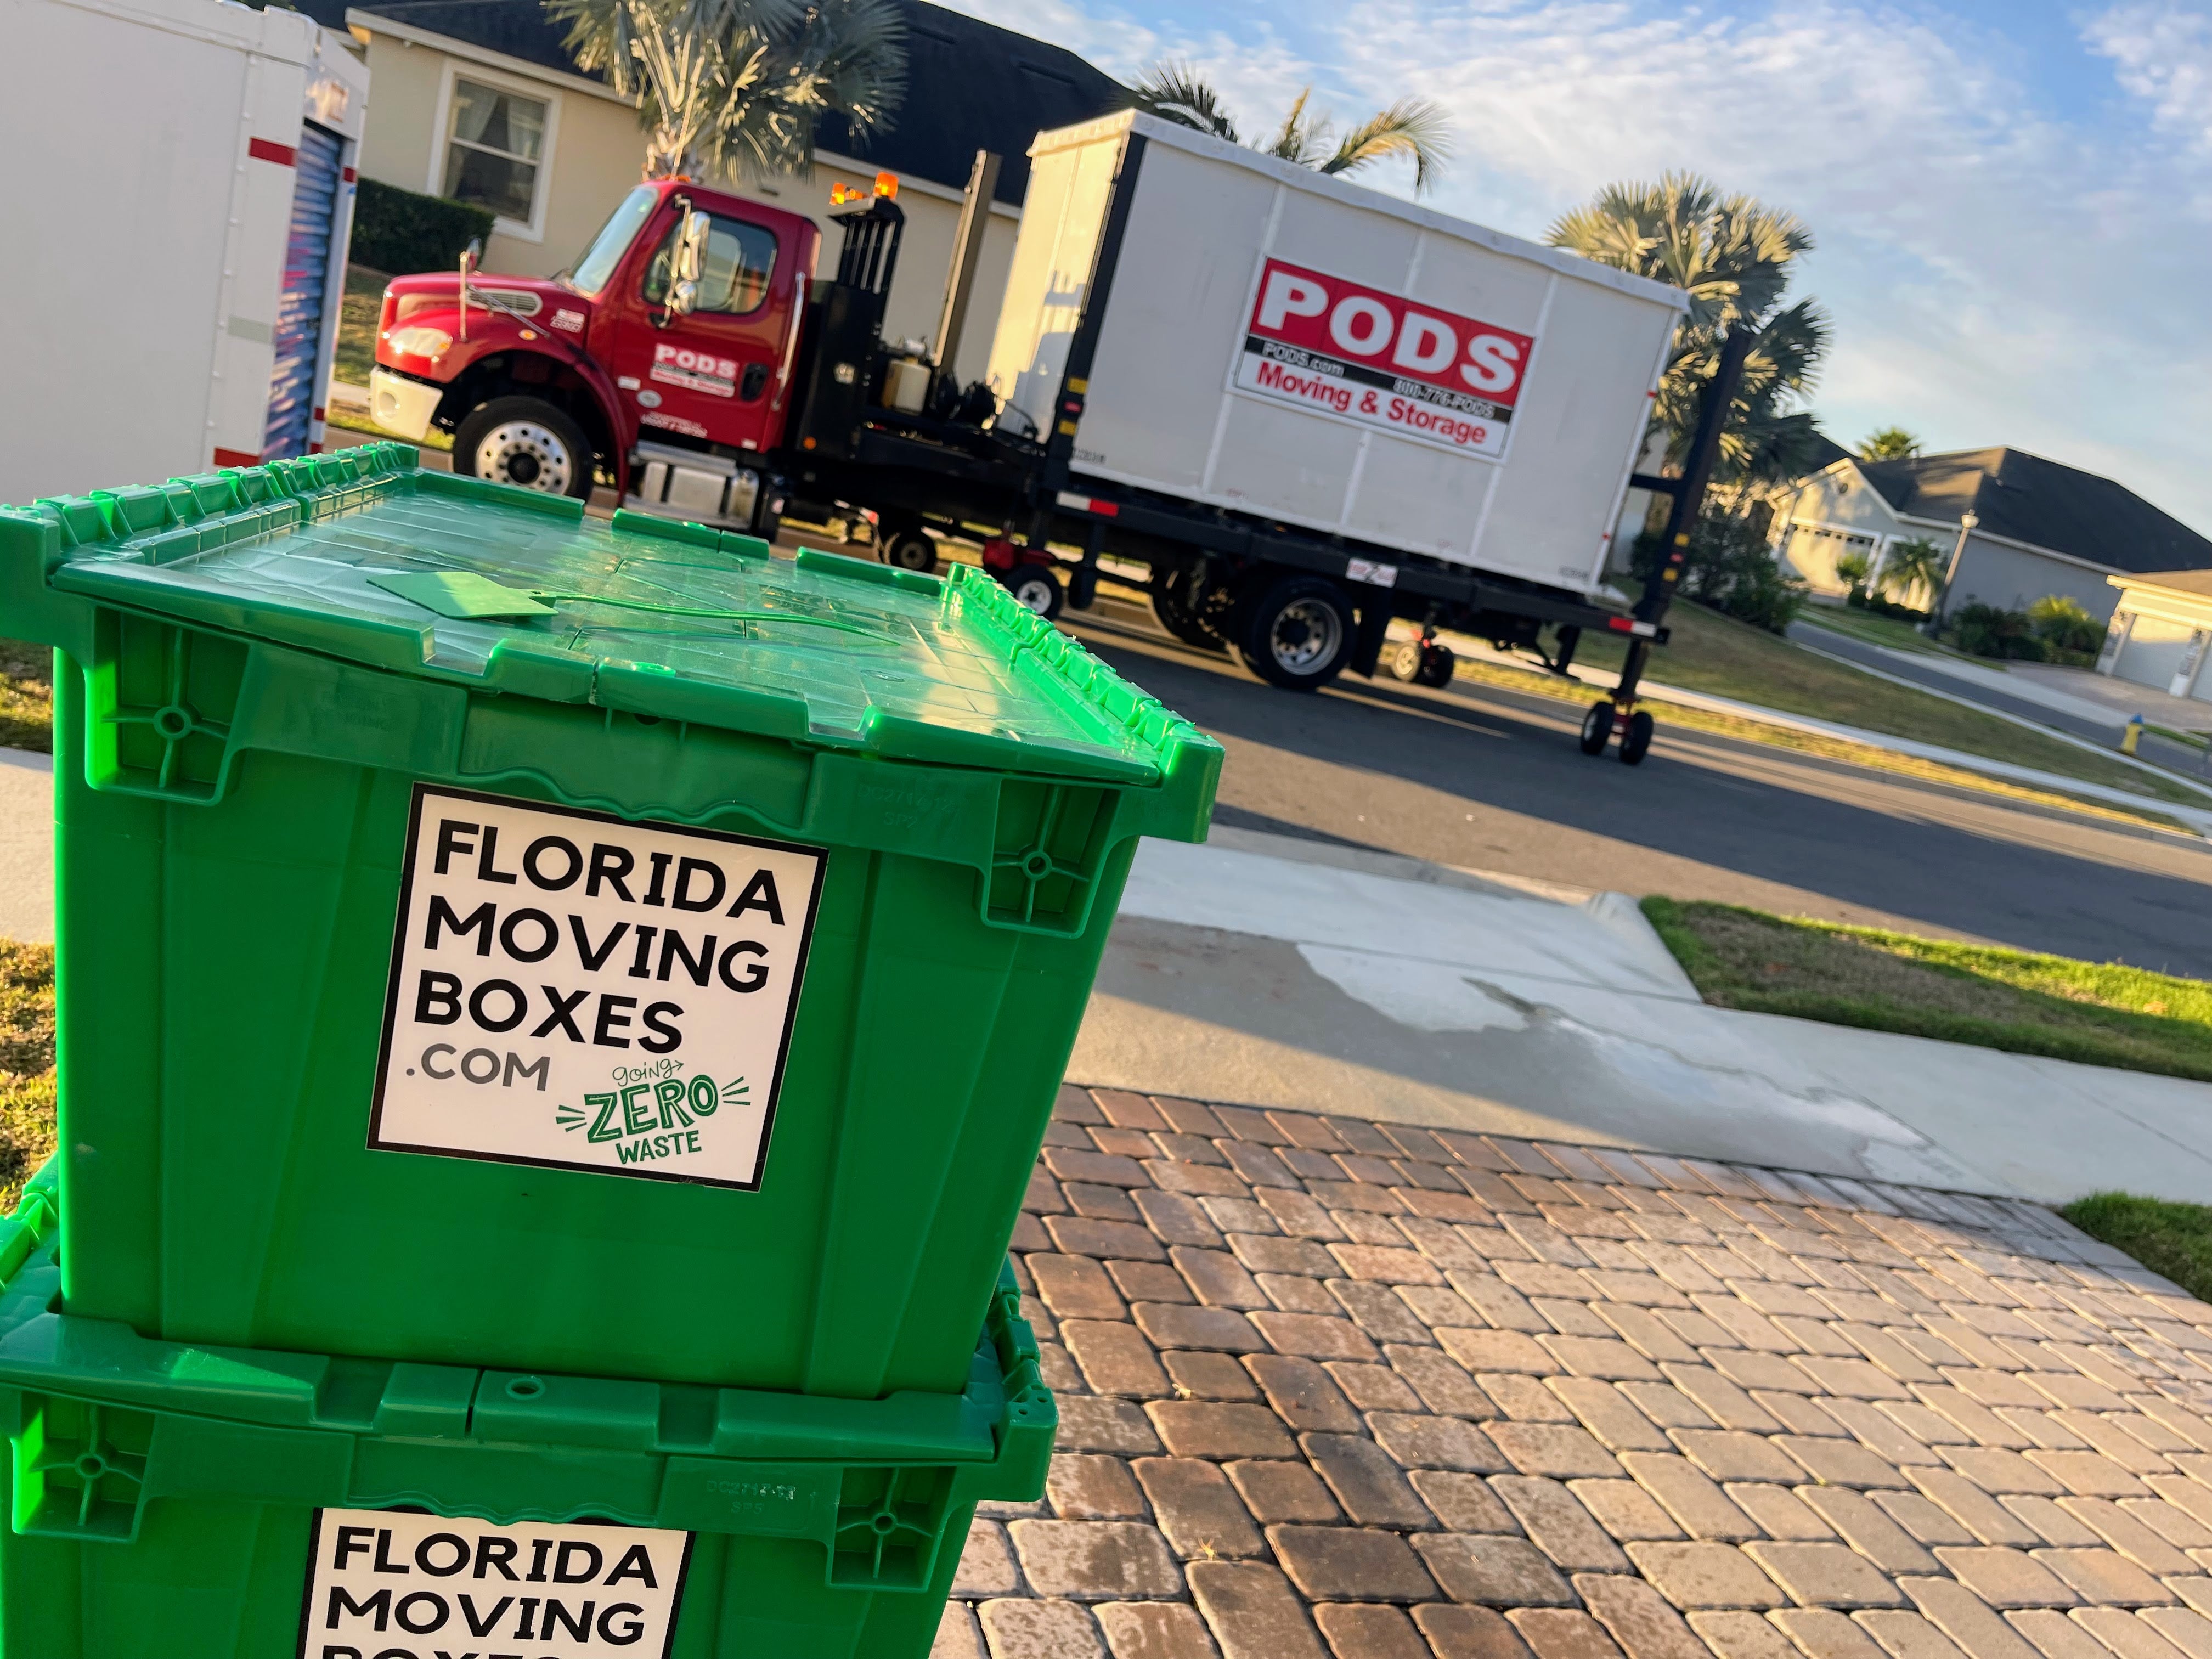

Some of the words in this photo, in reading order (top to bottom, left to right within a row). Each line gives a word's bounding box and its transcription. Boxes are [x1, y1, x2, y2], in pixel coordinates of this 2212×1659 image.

[655, 344, 737, 379] PODS
[1258, 269, 1520, 394] PODS
[1256, 361, 1351, 412] Moving
[1360, 391, 1378, 415] &
[1387, 398, 1487, 444] Storage
[434, 818, 785, 926] FLORIDA
[424, 895, 770, 994] MOVING
[414, 969, 685, 1054] BOXES
[406, 1043, 551, 1092] .COM
[584, 1074, 719, 1143] ZERO
[616, 1130, 702, 1165] WASTE
[334, 1526, 658, 1589] FLORIDA
[325, 1586, 645, 1646] MOVING
